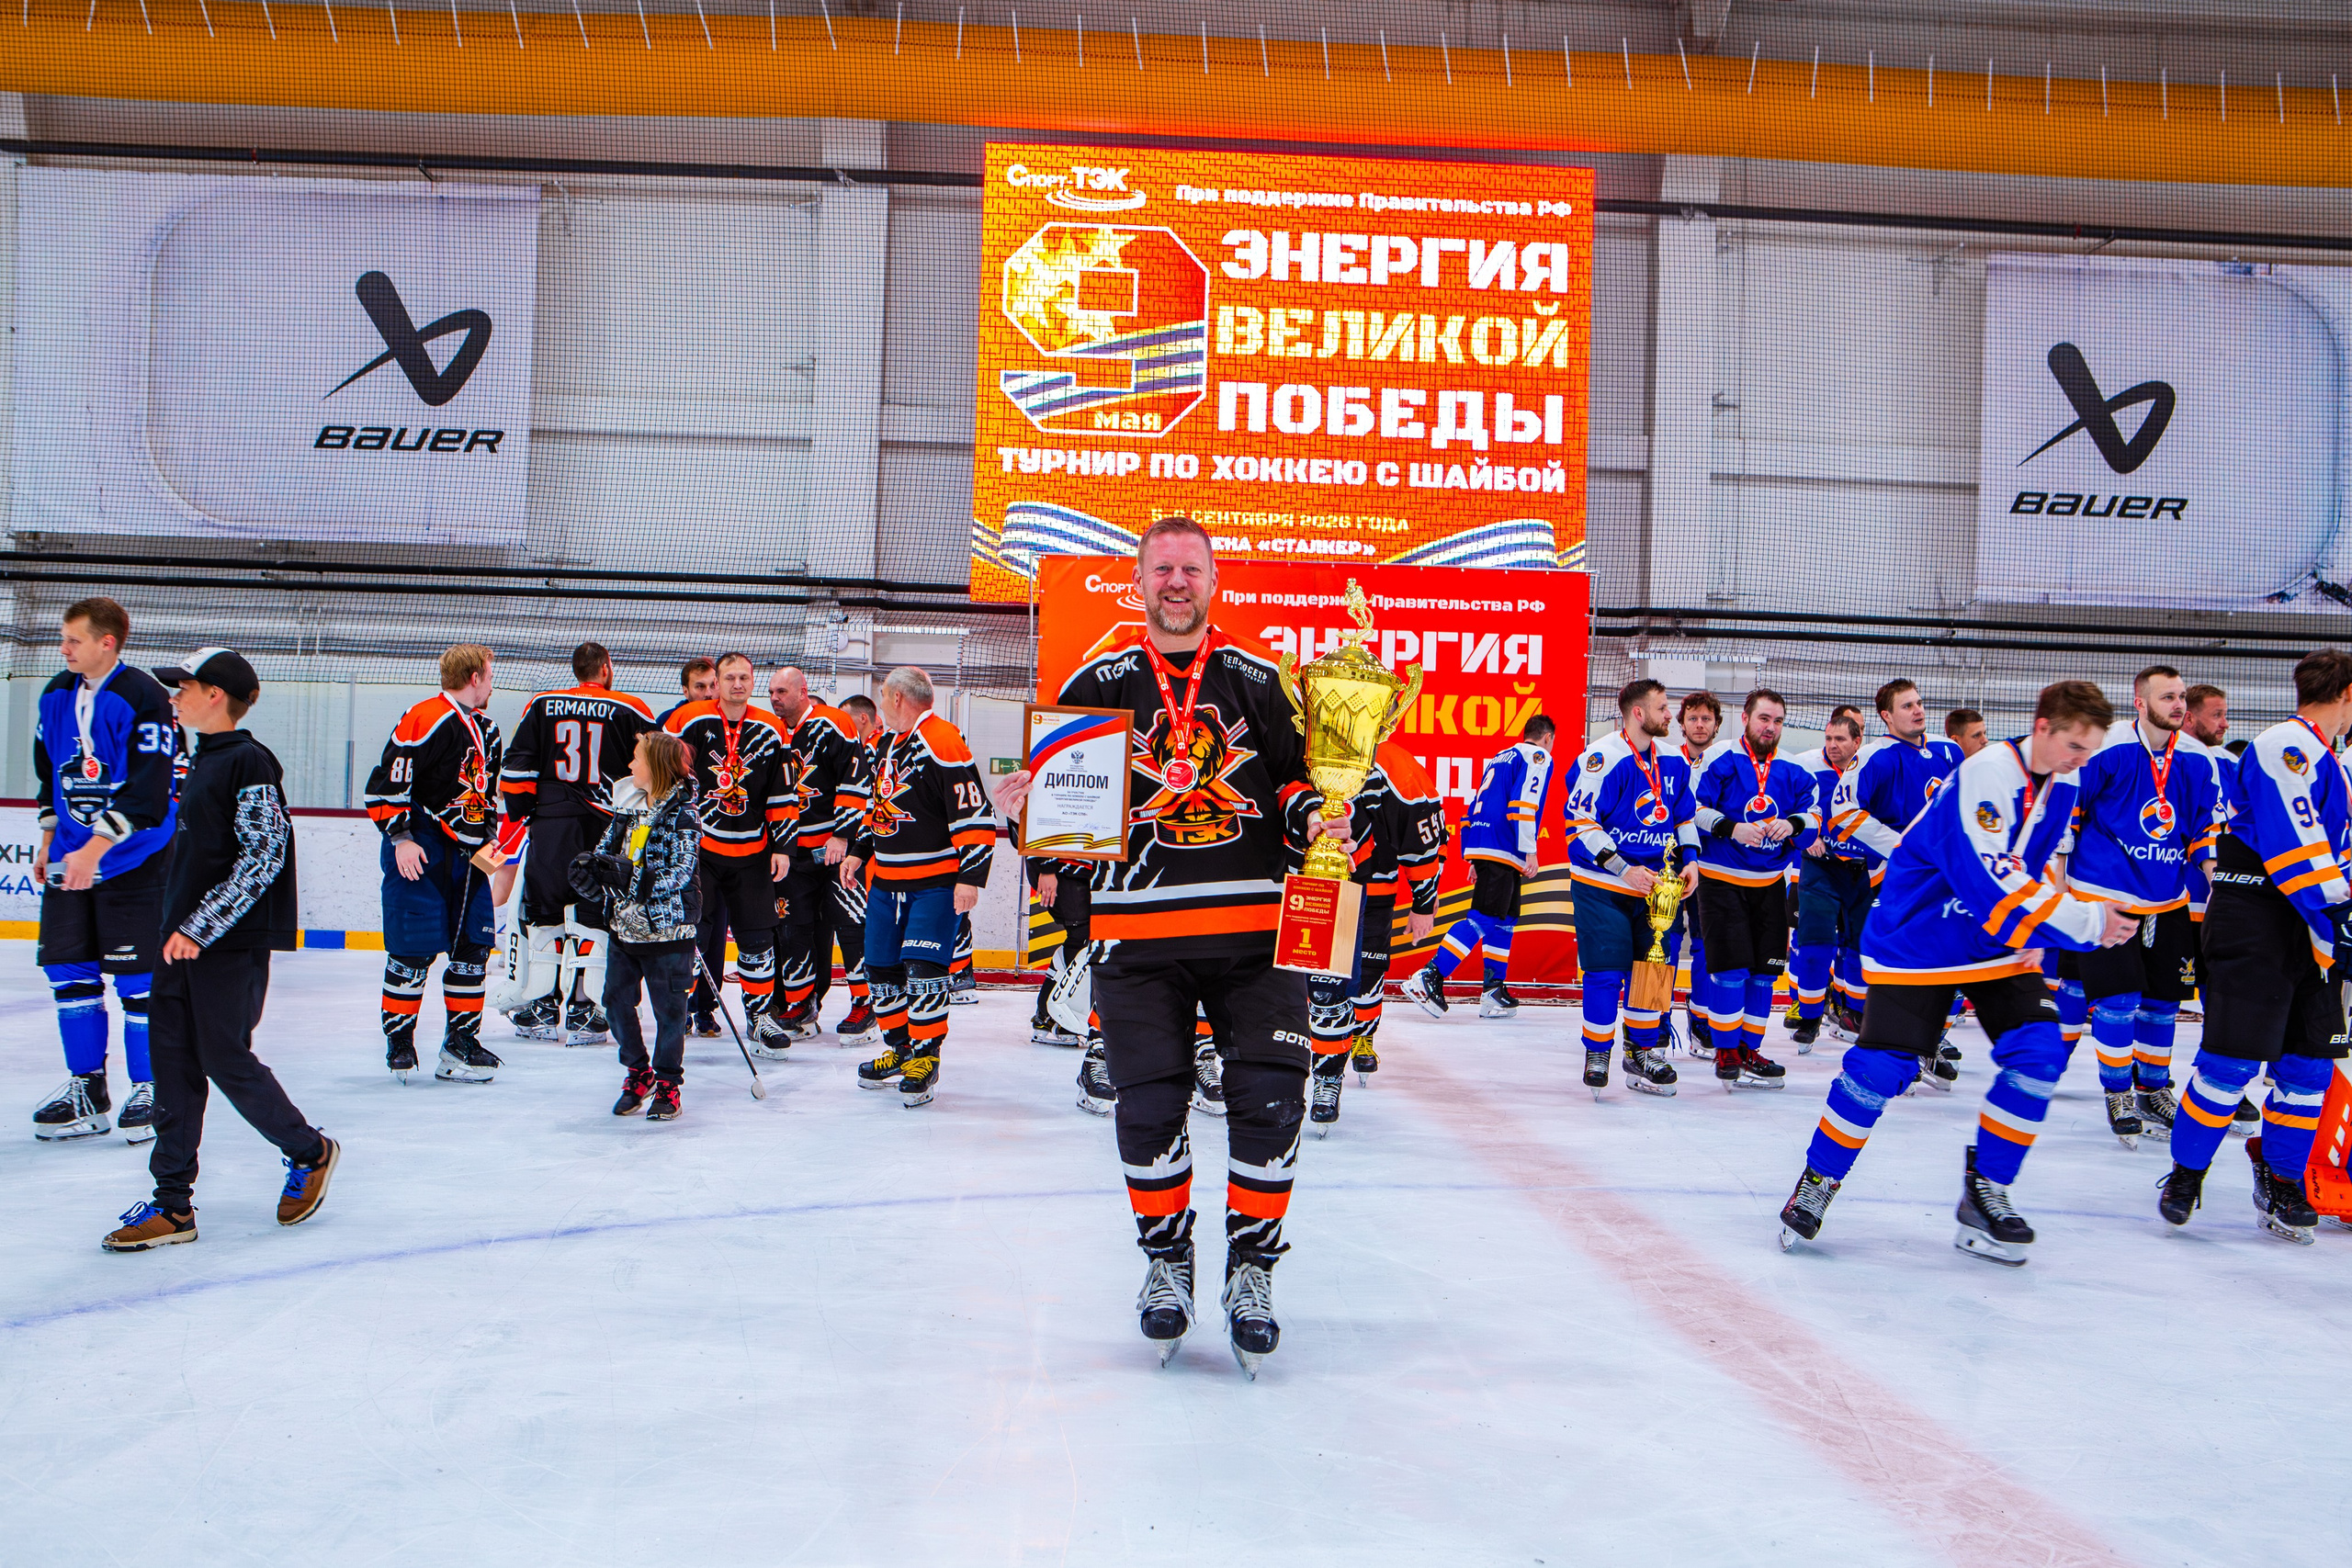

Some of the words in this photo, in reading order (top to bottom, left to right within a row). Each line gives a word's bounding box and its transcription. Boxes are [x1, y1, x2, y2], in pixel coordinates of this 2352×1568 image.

[1176, 184, 1219, 204] При
[1359, 192, 1532, 216] Правительства
[1537, 199, 1572, 218] РФ
[1221, 229, 1568, 293] ЭНЕРГИЯ
[1215, 300, 1568, 369] ВЕЛИКОЙ
[1217, 379, 1563, 451] ПОБЕДЫ
[313, 425, 504, 454] BAUER
[997, 446, 1141, 477] ТУРНИР
[1149, 452, 1200, 479] ПО
[1210, 455, 1367, 485] ХОККЕЮ
[1376, 461, 1399, 487] С
[1409, 457, 1566, 493] ШАЙБОЙ
[2009, 491, 2188, 521] BAUER
[1190, 509, 1295, 527] СЕНТЯБРЯ
[1356, 515, 1410, 534] ГОДА
[1210, 536, 1252, 551] ЕНА
[1222, 590, 1256, 604] При
[1261, 592, 1351, 608] поддерж
[1372, 594, 1513, 612] Правительства
[1518, 600, 1546, 613] РФ
[1395, 682, 1543, 737] ИКОЙ
[137, 723, 174, 756] 33
[554, 719, 604, 784] 31
[1045, 772, 1109, 789] ДИПЛОМ
[1530, 776, 1540, 795] 2
[953, 781, 983, 810] 28
[1568, 788, 1594, 814] 94
[1162, 818, 1235, 843] ТЭК
[1609, 827, 1675, 847] РусГидр
[1289, 894, 1305, 911] 9
[1306, 895, 1331, 903] ЭНЕРГИЯ
[1299, 928, 1311, 948] 1
[508, 931, 519, 982] CCM
[1361, 951, 1387, 961] UER
[1052, 959, 1078, 1002] CCM
[1309, 975, 1343, 986] CCM
